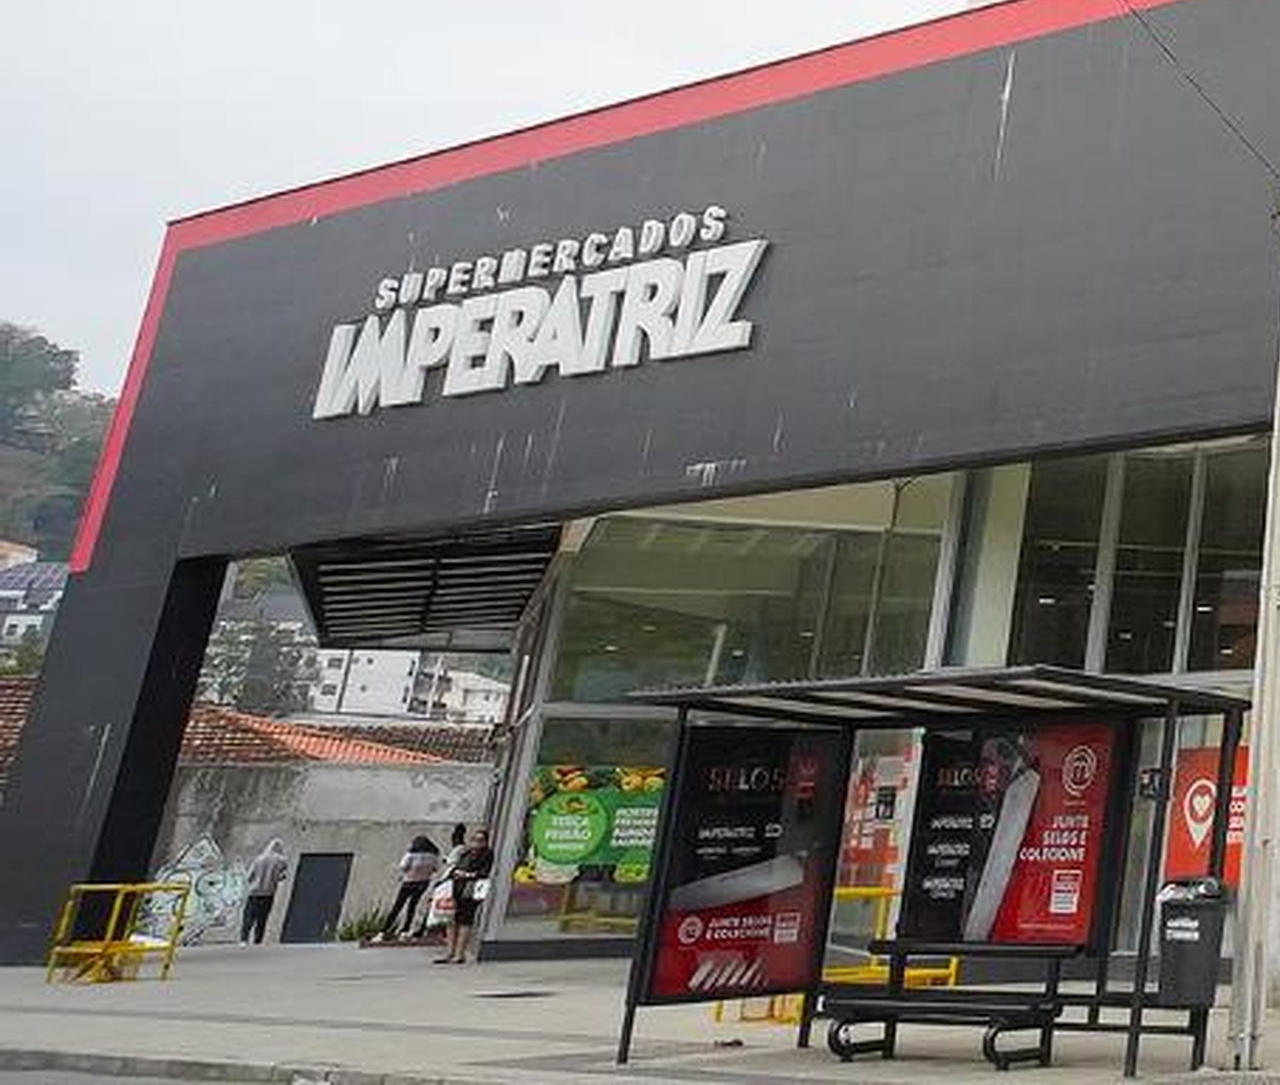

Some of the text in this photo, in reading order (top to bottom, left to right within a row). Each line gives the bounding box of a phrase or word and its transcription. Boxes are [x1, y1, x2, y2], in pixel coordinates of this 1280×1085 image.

[374, 205, 727, 309] SUPERMERCADOS
[313, 239, 769, 420] IMPERATRIZ
[1052, 816, 1089, 829] JUNTE
[1042, 830, 1087, 846] SELOS E
[1019, 846, 1086, 862] COLECIONE
